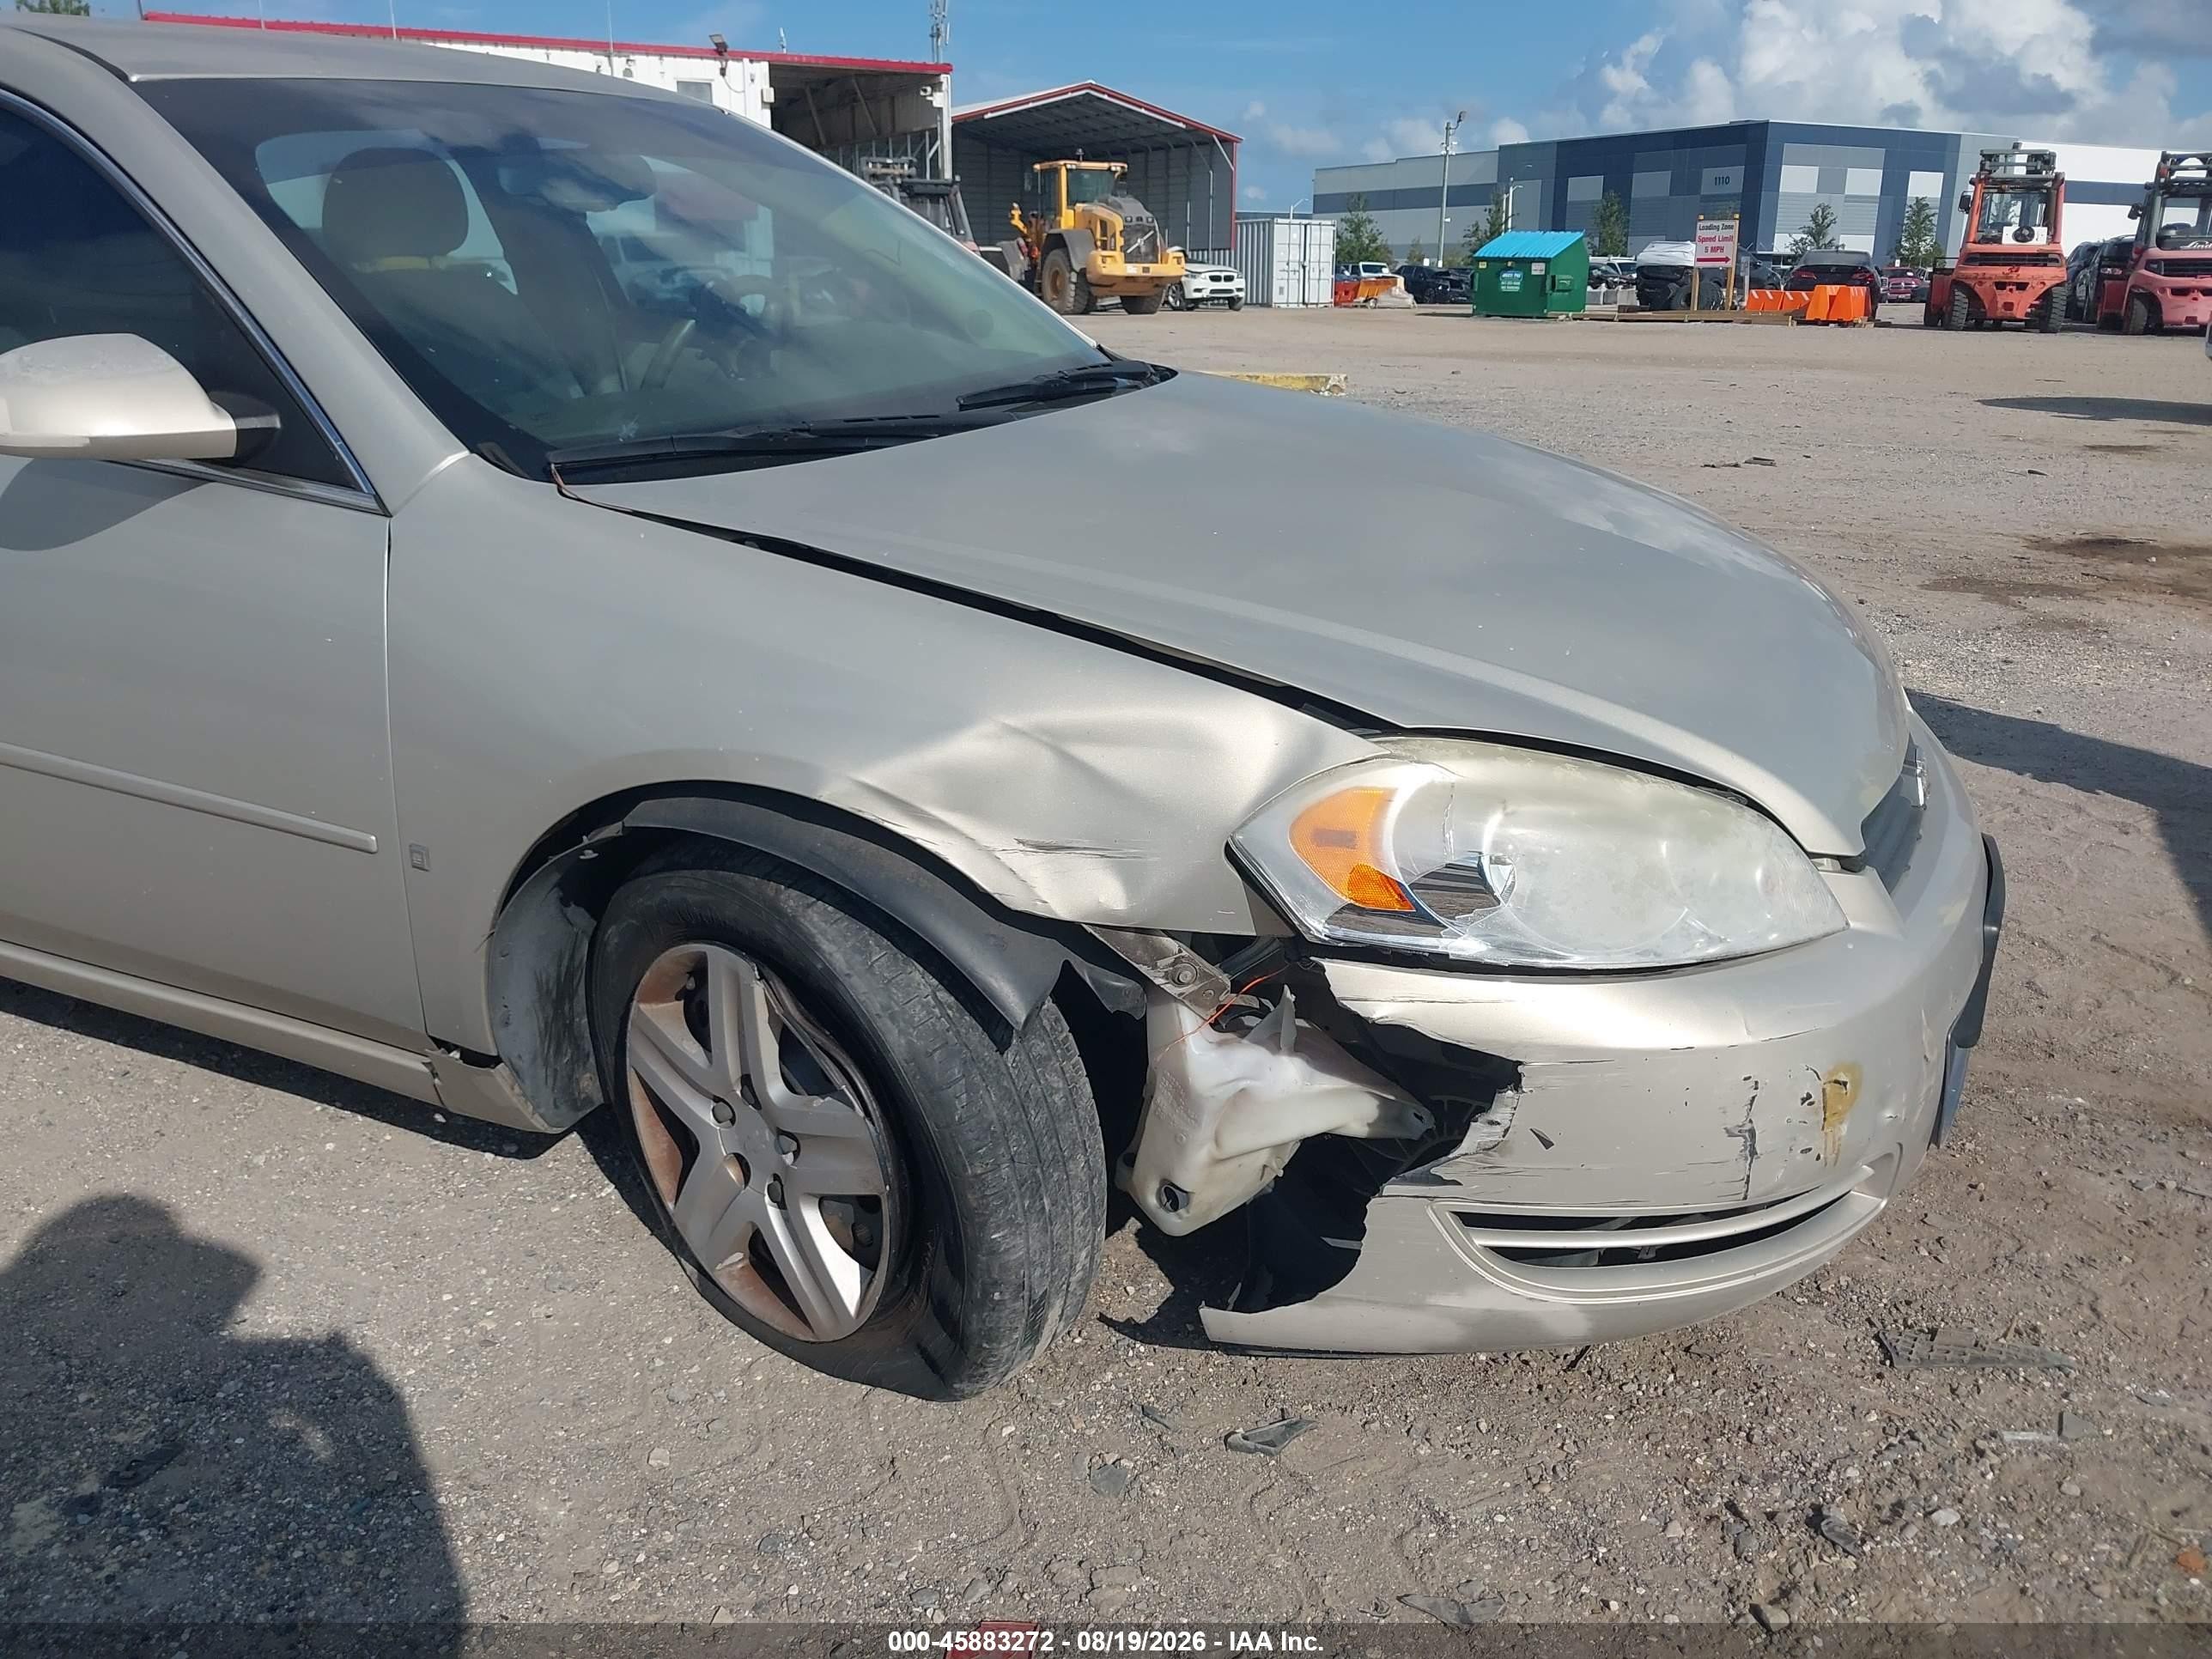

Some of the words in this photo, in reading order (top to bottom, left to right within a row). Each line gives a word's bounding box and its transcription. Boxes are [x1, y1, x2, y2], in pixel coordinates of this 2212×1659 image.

[1714, 176, 1730, 186] 1110
[1698, 223, 1720, 232] Loading
[1698, 234, 1717, 244] Speed
